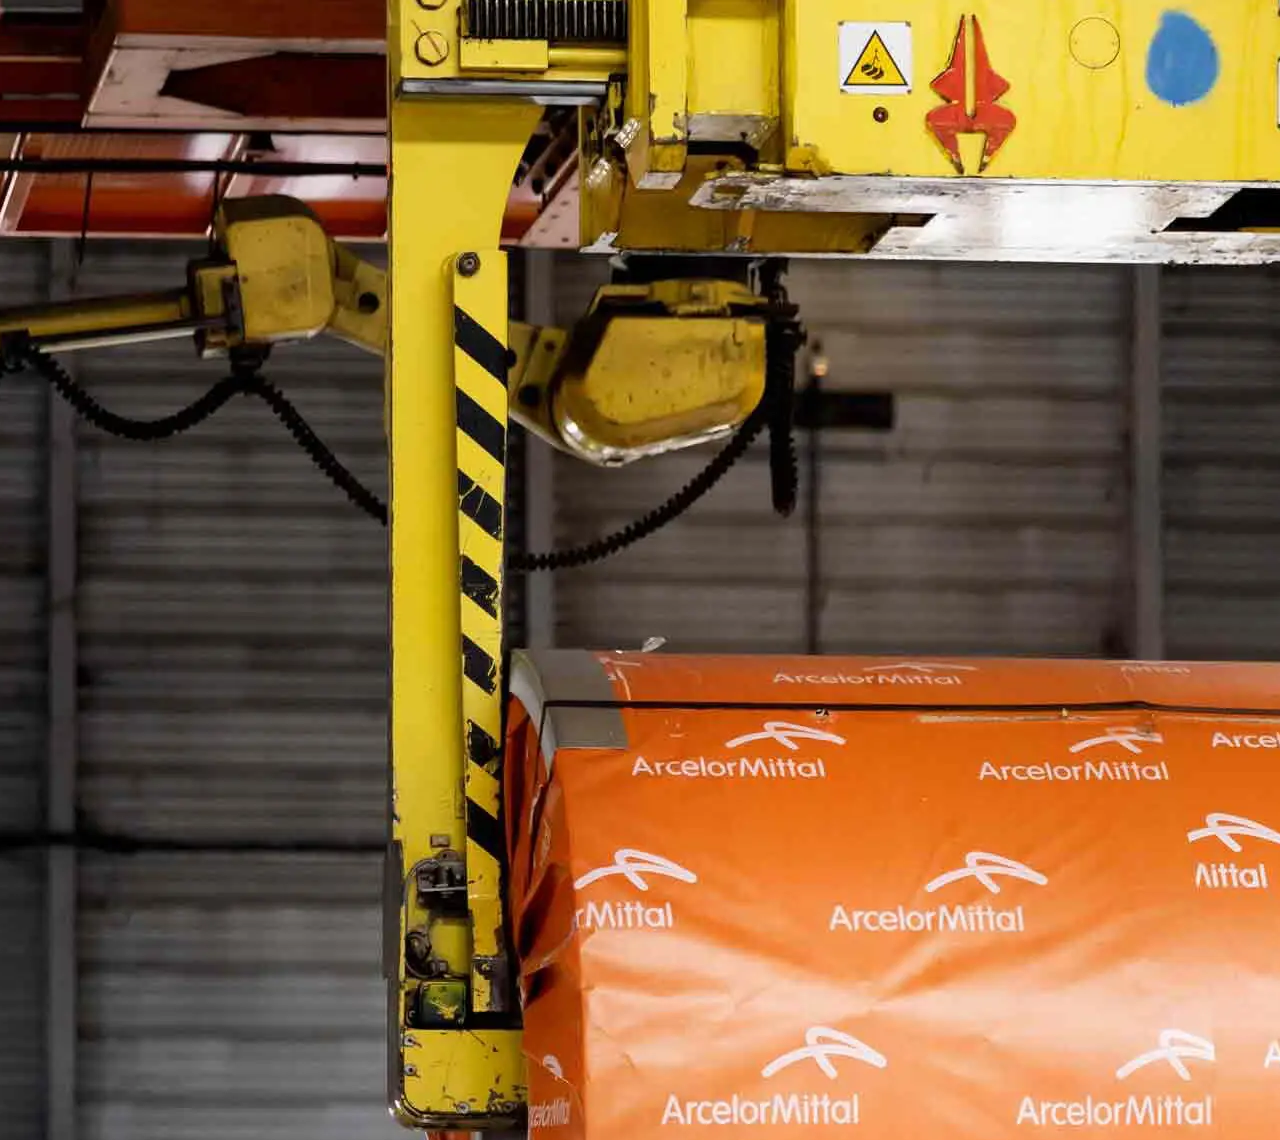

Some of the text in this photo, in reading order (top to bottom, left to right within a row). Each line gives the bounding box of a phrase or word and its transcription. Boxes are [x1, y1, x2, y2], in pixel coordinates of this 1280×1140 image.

[773, 671, 963, 686] ArcelorMittal
[631, 756, 826, 778] ArcelorMittal
[979, 761, 1169, 781] ArcelorMittal
[575, 901, 673, 928] rMittal
[830, 906, 1022, 932] ArcelorMittal
[662, 1094, 858, 1123] ArcelorMittal
[1016, 1096, 1212, 1125] ArcelorMittal
